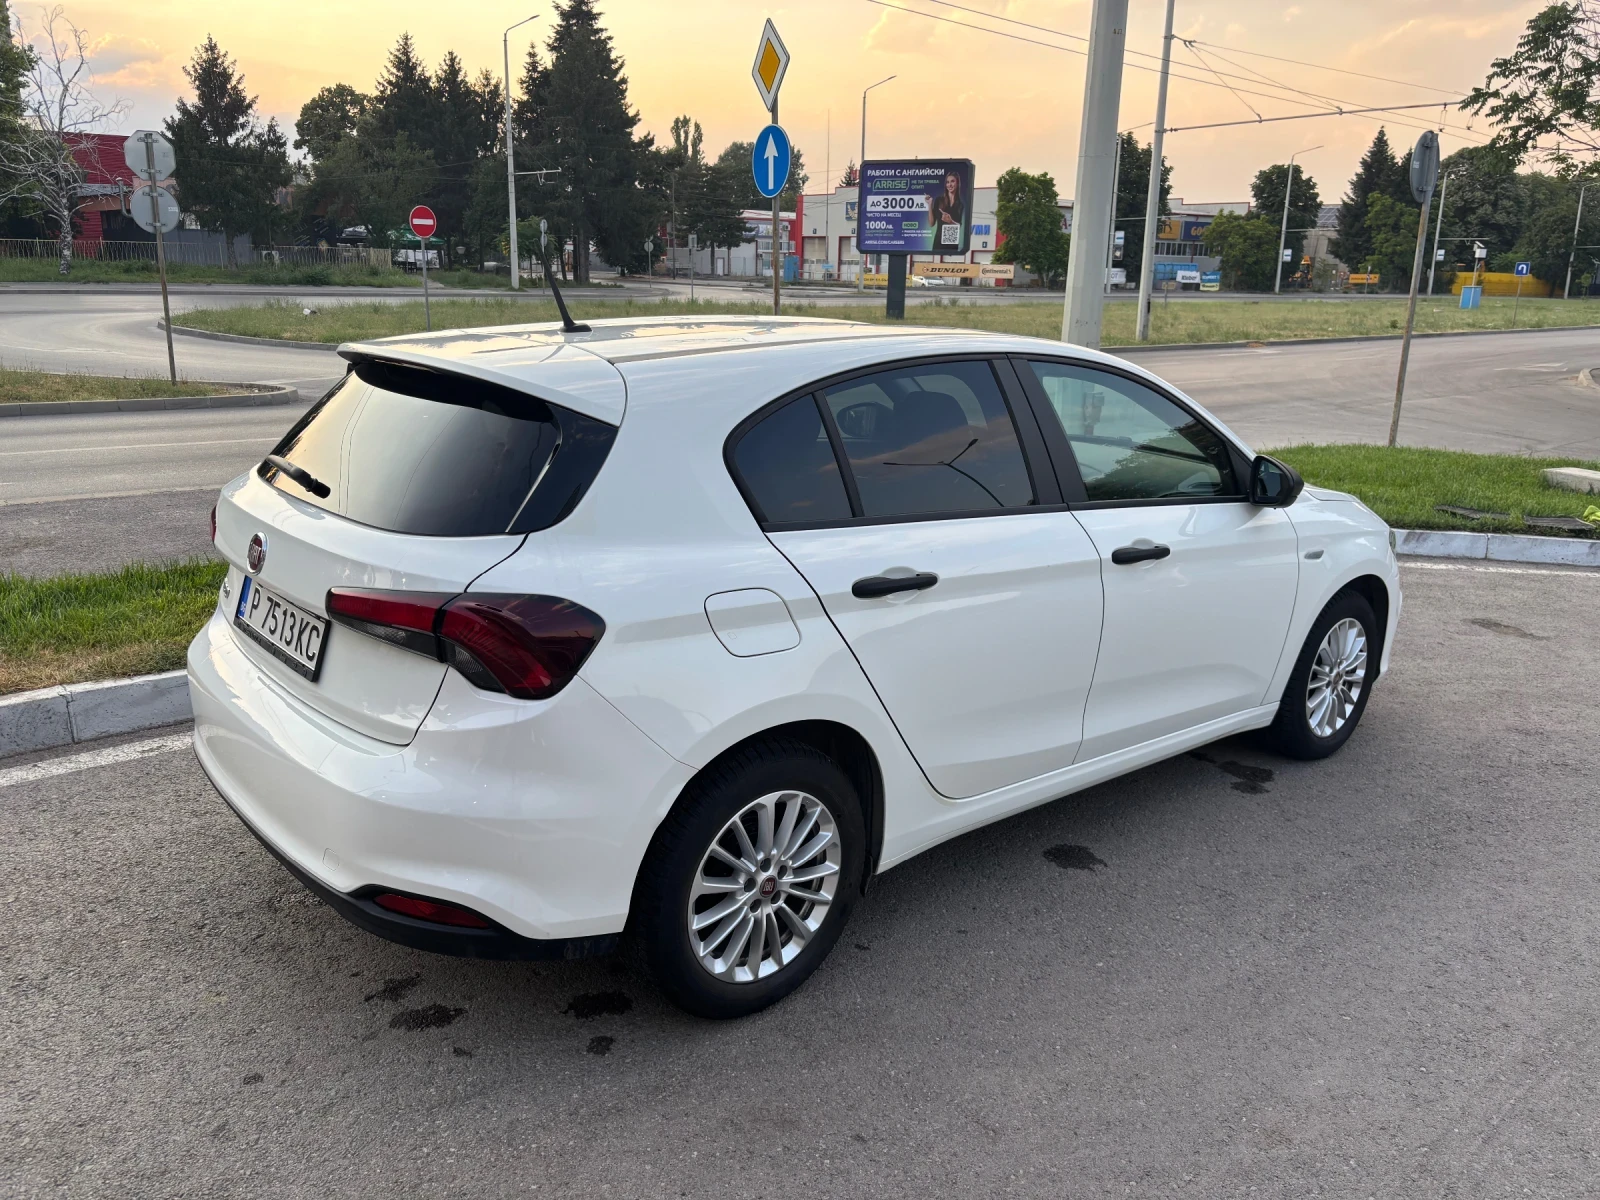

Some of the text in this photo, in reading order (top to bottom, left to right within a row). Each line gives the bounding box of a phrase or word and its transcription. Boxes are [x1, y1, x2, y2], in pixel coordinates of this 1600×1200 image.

[867, 169, 895, 177] РАБОТИ
[902, 168, 945, 176] АНГЛИЙСКИ
[874, 180, 908, 189] ARRISE
[882, 198, 914, 209] 3000
